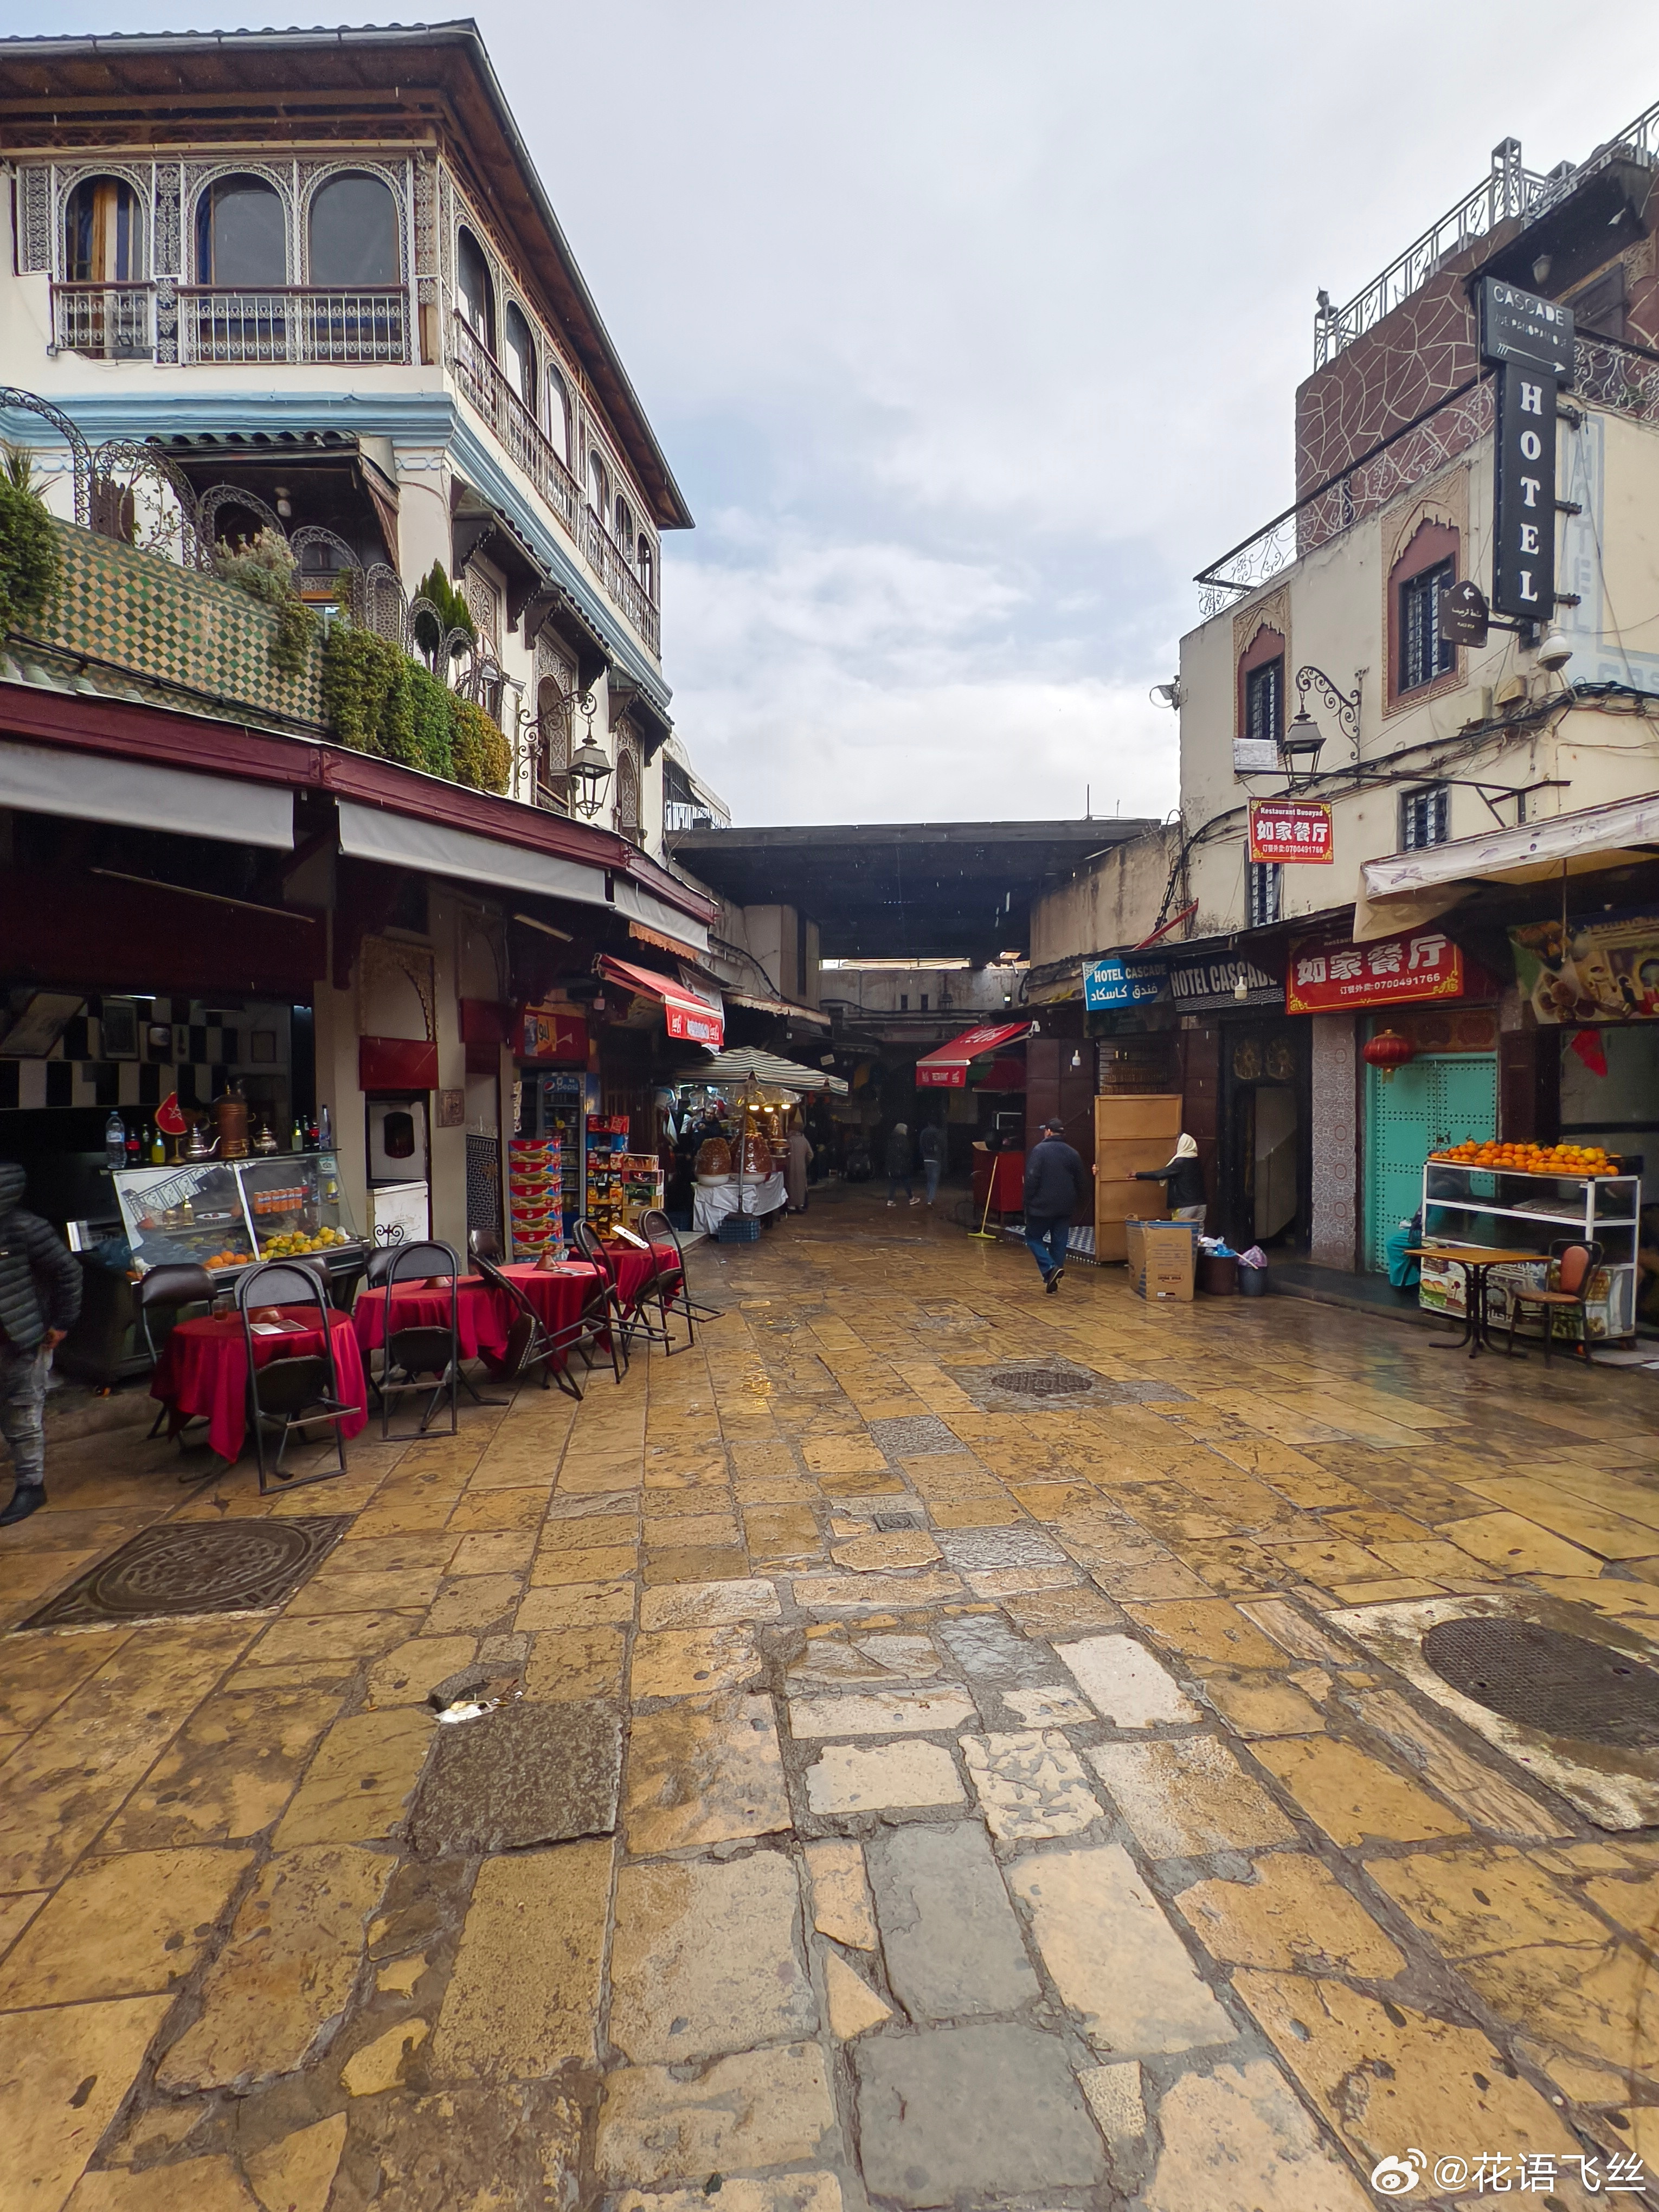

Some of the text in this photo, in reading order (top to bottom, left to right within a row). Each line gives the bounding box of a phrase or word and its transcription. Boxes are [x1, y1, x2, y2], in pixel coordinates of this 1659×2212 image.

[1494, 286, 1564, 326] CASCADE
[1520, 382, 1542, 602] HOTEL
[1261, 807, 1295, 815] Restaurant
[1256, 820, 1328, 842] 如家餐厅
[1323, 937, 1352, 946] Restaur
[1297, 934, 1447, 986] 如家餐厅
[1094, 964, 1167, 983] HOTEL CASCADE
[1170, 967, 1210, 997] HOTEL
[1091, 983, 1158, 1001] فندق كاسكاد
